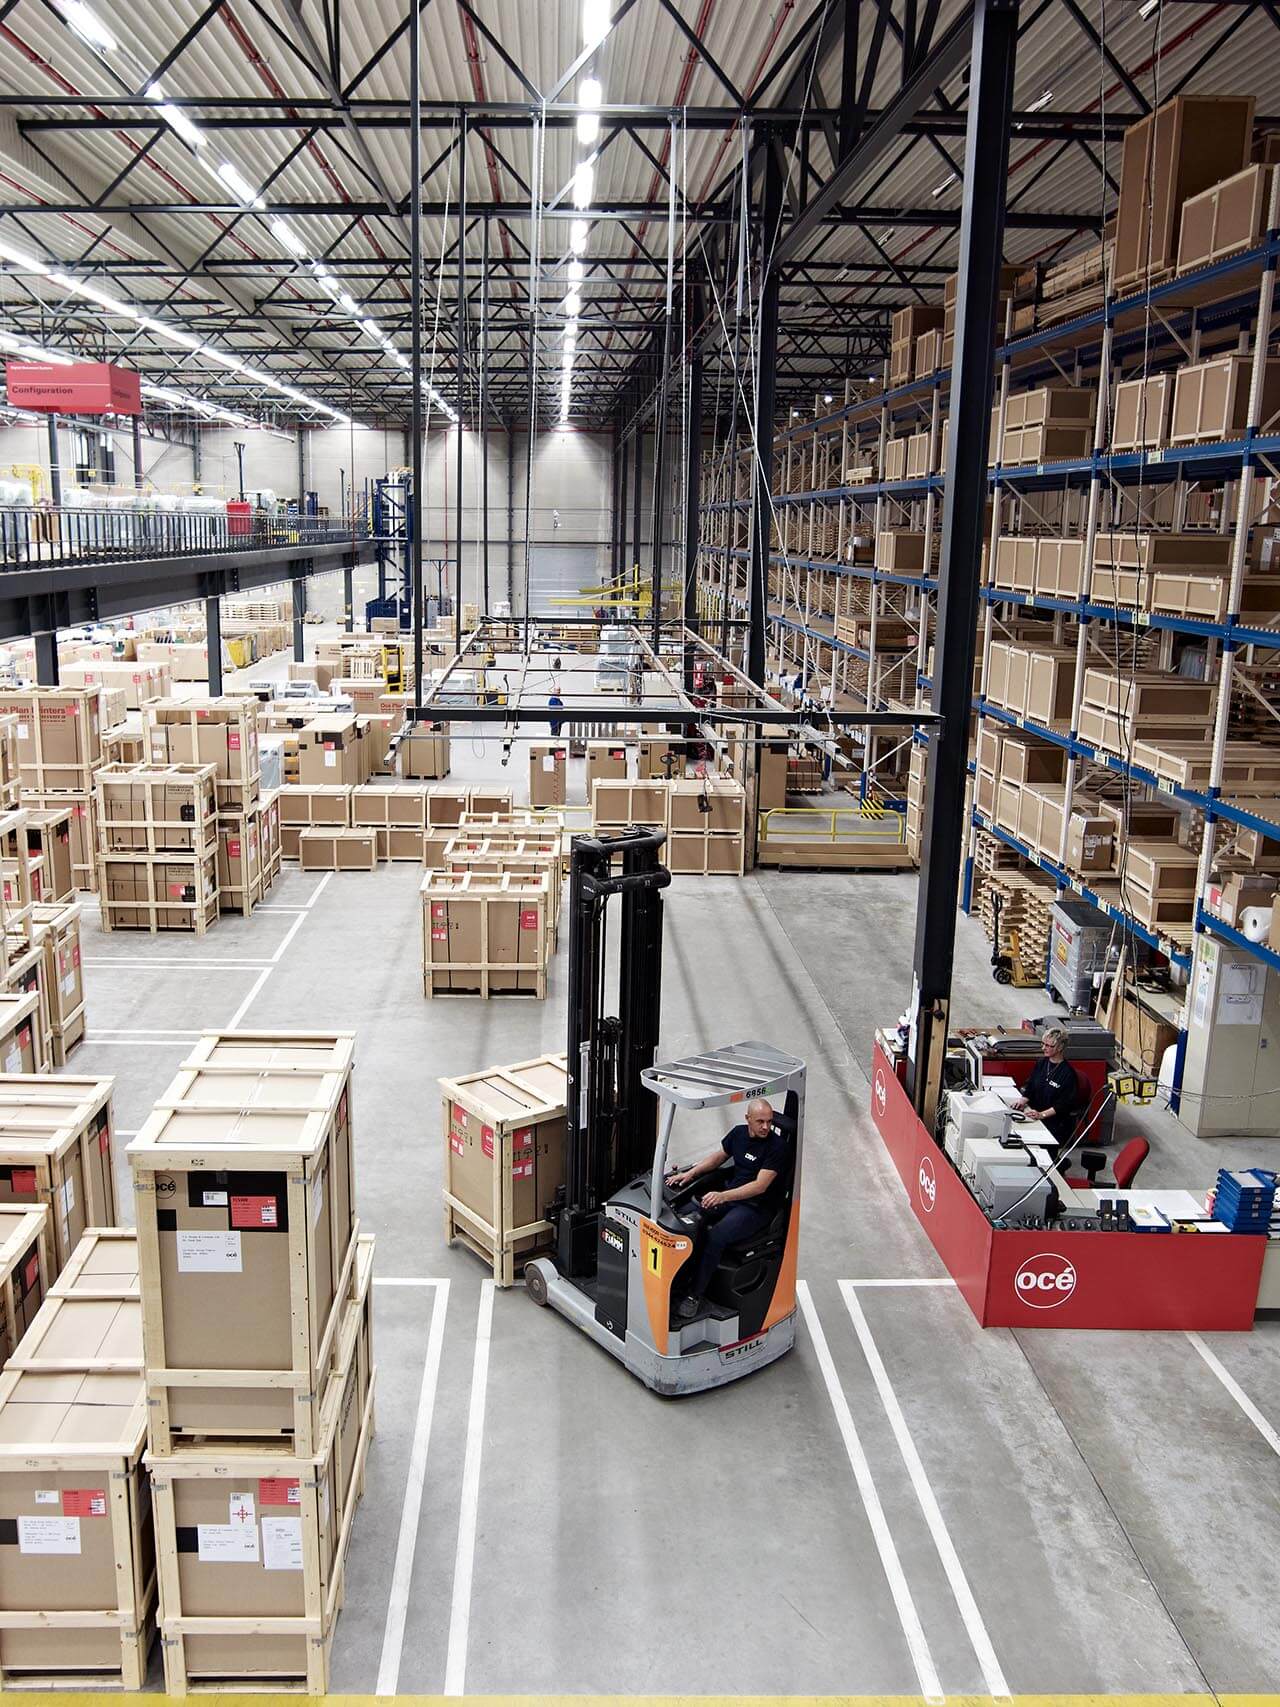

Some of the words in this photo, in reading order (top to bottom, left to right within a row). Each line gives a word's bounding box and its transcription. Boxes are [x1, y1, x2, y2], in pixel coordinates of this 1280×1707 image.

[12, 386, 73, 395] Configuration
[10, 706, 29, 714] Plan
[875, 1080, 886, 1106] océ
[919, 1168, 936, 1202] océ
[615, 1208, 638, 1227] STILL
[651, 1247, 658, 1270] 1
[1017, 1267, 1074, 1290] océ
[725, 1340, 763, 1359] STILL
